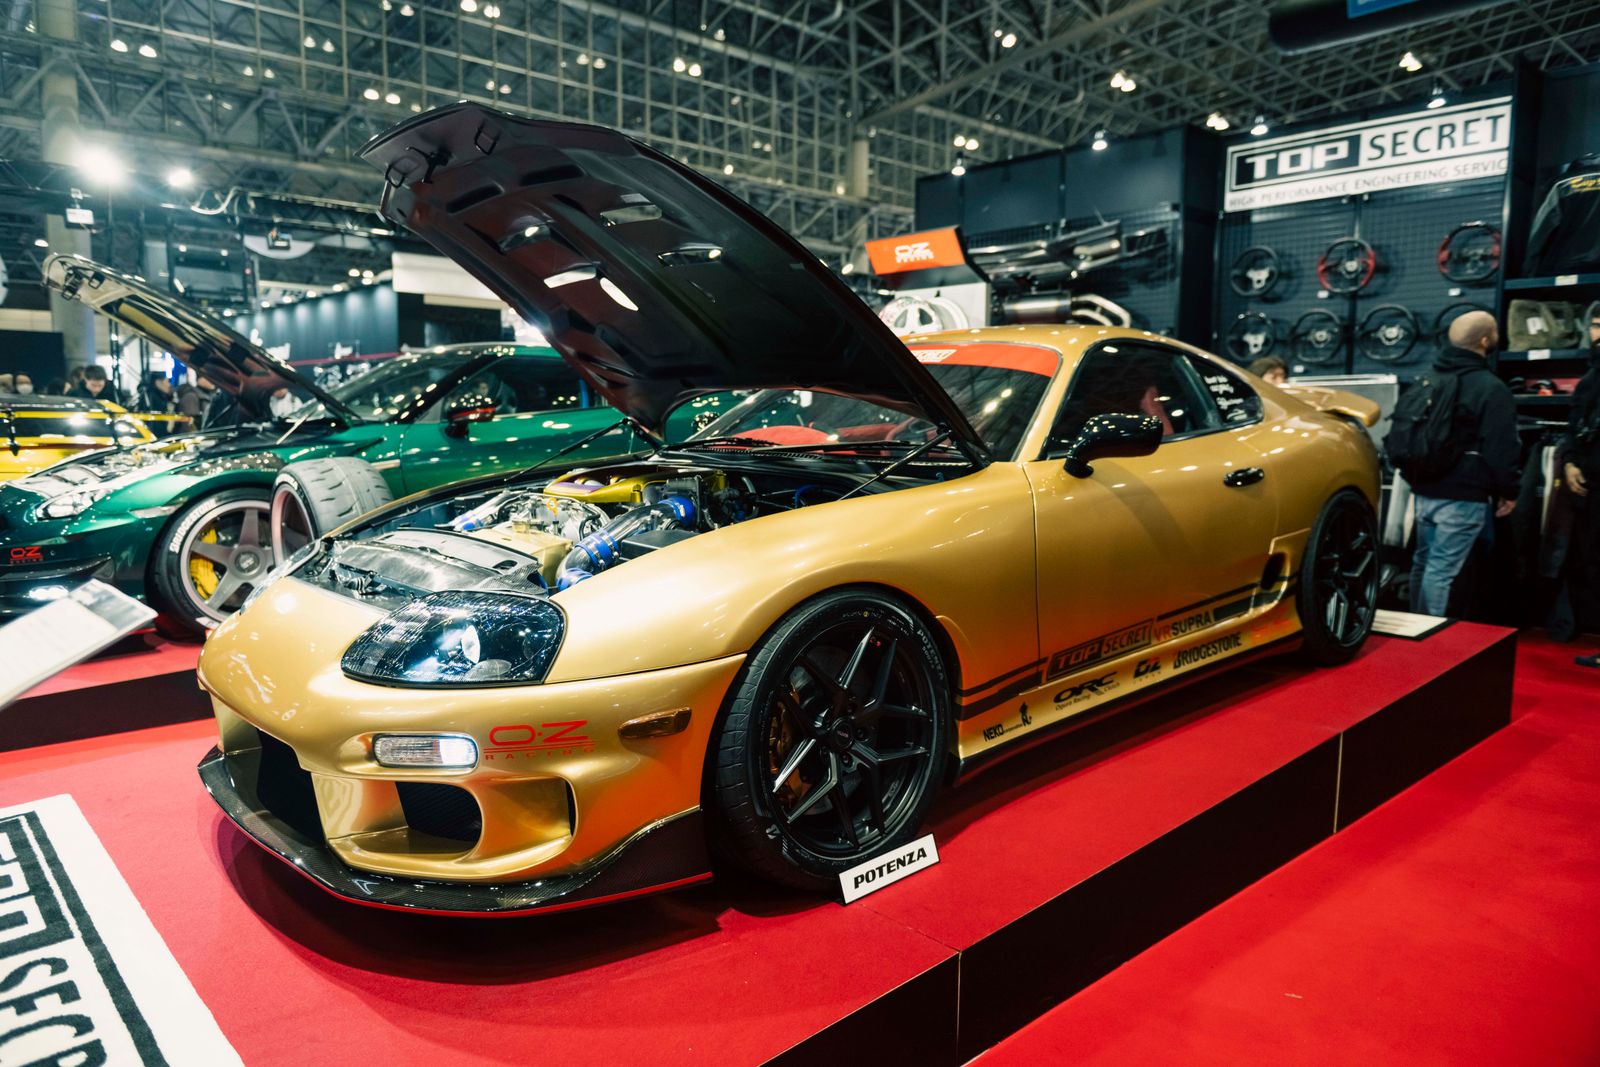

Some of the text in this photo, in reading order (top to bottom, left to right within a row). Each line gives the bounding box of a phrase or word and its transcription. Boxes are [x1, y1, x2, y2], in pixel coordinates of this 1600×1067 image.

[1245, 113, 1506, 179] TOP SECRET
[1354, 167, 1449, 190] ENGINEERING
[1057, 641, 1100, 669] TOP
[1103, 624, 1150, 655] SECRET
[1173, 631, 1243, 669] BRIDGESTONE
[1053, 671, 1118, 703] ORC
[484, 747, 595, 761] RACING
[853, 847, 928, 889] POTENZA
